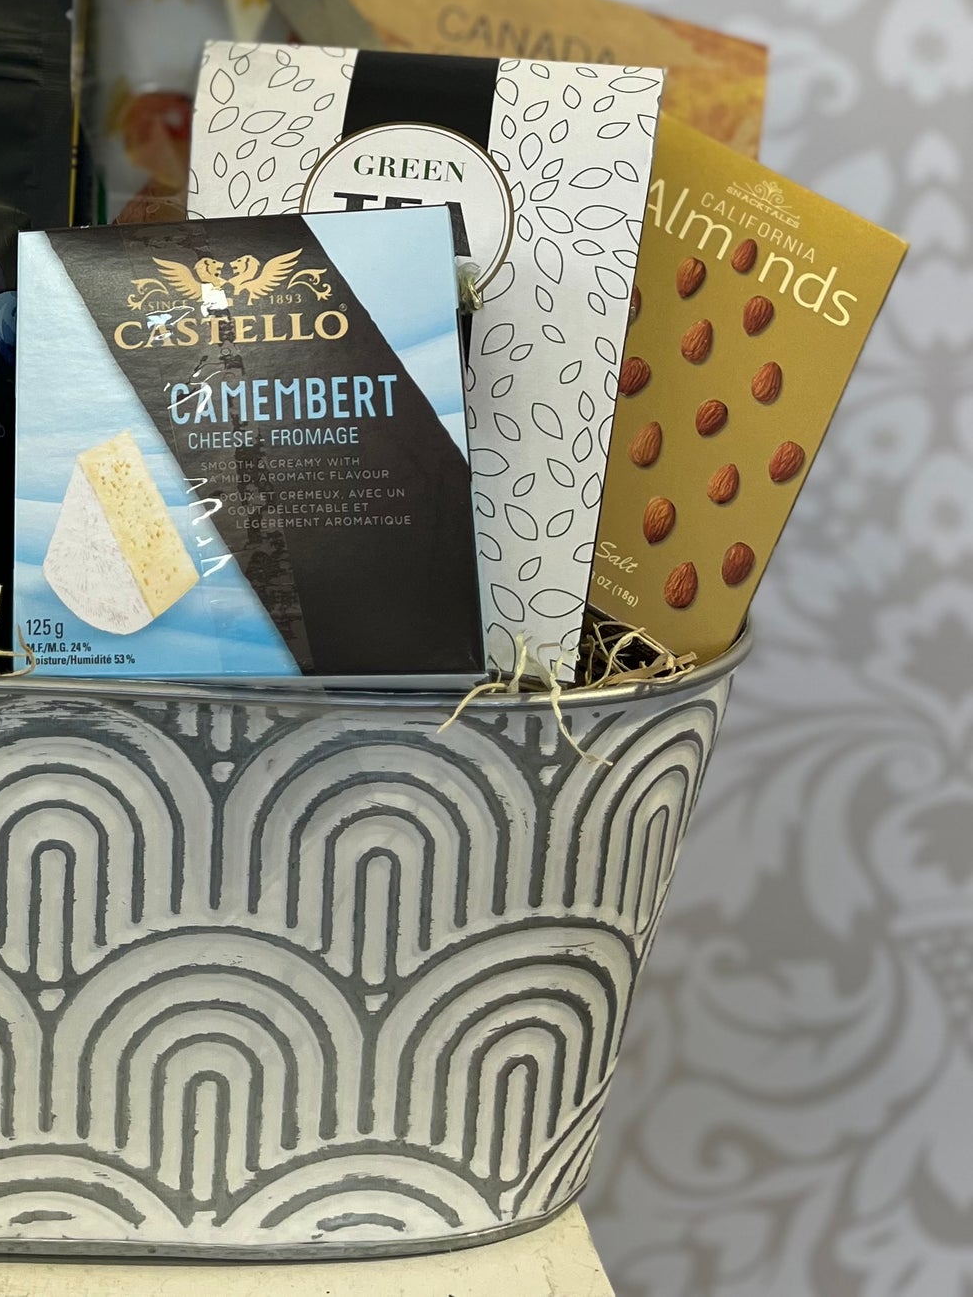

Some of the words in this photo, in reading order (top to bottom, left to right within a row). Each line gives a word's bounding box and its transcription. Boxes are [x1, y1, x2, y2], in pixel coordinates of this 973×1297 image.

[353, 154, 467, 183] GREEN
[726, 186, 800, 229] SNACKTALES
[700, 192, 815, 264] CALIFORNIA
[269, 294, 303, 304] 1893
[113, 309, 349, 350] CASTELLO
[170, 374, 398, 425] CAMEMBERT
[188, 430, 254, 450] CHEESE
[271, 426, 360, 446] FROMAGE
[201, 460, 253, 471] SMOOTH
[257, 459, 266, 469] &
[269, 458, 322, 469] CREAMY
[327, 457, 360, 467] WITH
[259, 471, 325, 483] AROMATIC
[330, 469, 390, 480] FLAVOUR
[220, 491, 255, 503] DOUX
[260, 491, 276, 501] ET
[348, 488, 382, 499] AVEC
[387, 488, 406, 498] UN
[353, 502, 369, 512] ET
[324, 515, 412, 527] AROMATIQUE
[595, 541, 639, 574] Salt
[597, 575, 612, 590] OZ
[612, 584, 639, 607] (18g)
[26, 619, 51, 635] 125
[55, 622, 64, 638] g
